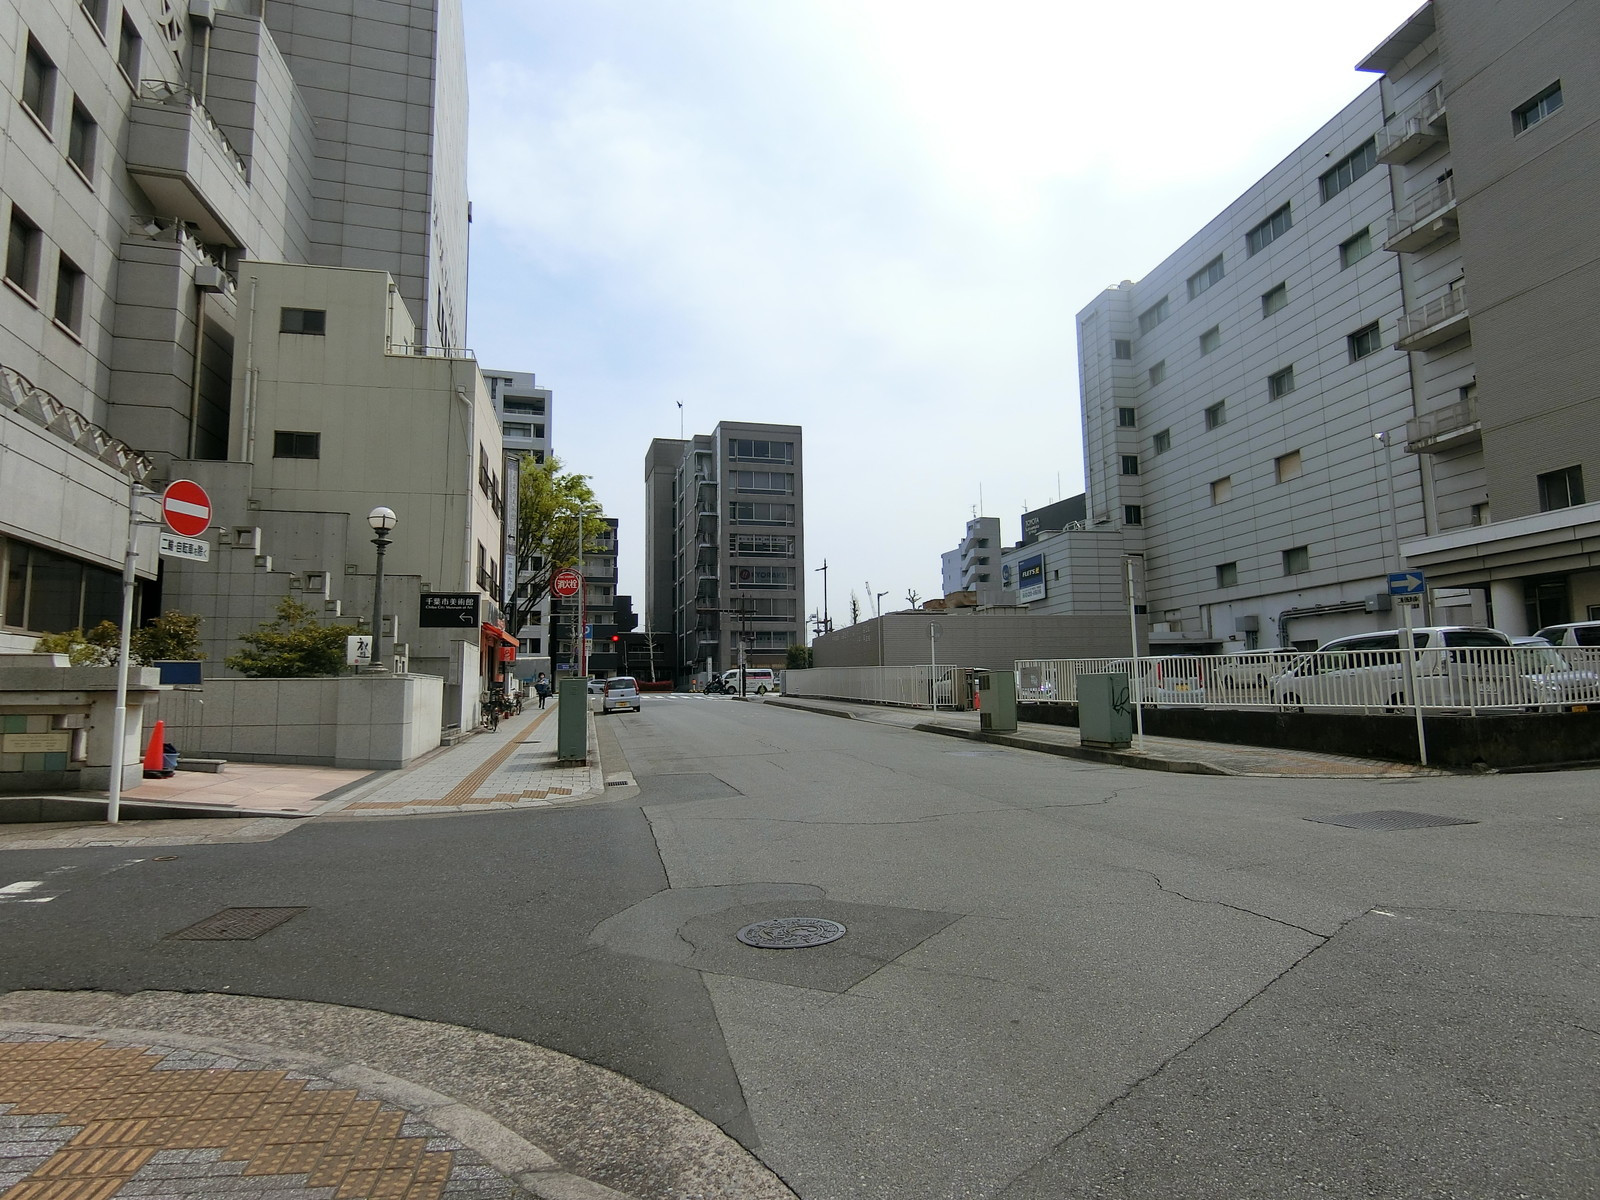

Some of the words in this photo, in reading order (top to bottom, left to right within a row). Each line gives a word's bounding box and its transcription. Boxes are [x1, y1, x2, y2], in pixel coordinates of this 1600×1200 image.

[557, 579, 578, 589] 消火栓
[425, 597, 474, 605] 千葉市美術館
